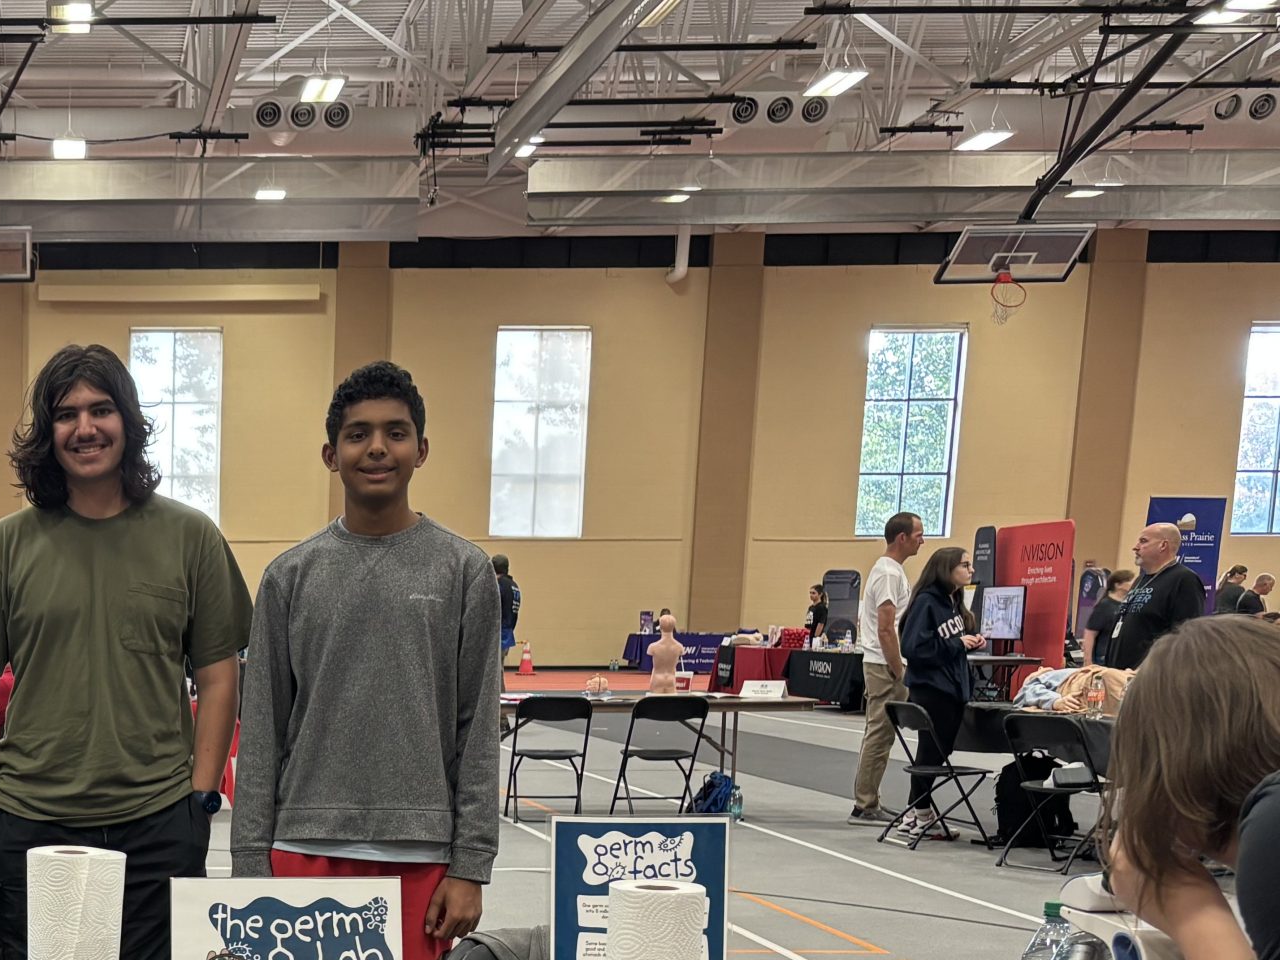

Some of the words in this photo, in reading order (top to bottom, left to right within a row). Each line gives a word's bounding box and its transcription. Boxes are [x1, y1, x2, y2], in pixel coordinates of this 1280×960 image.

[1189, 532, 1215, 541] Prairie
[1021, 541, 1065, 562] INVISION
[592, 839, 654, 876] germ
[628, 851, 694, 880] facts
[213, 904, 264, 940] the
